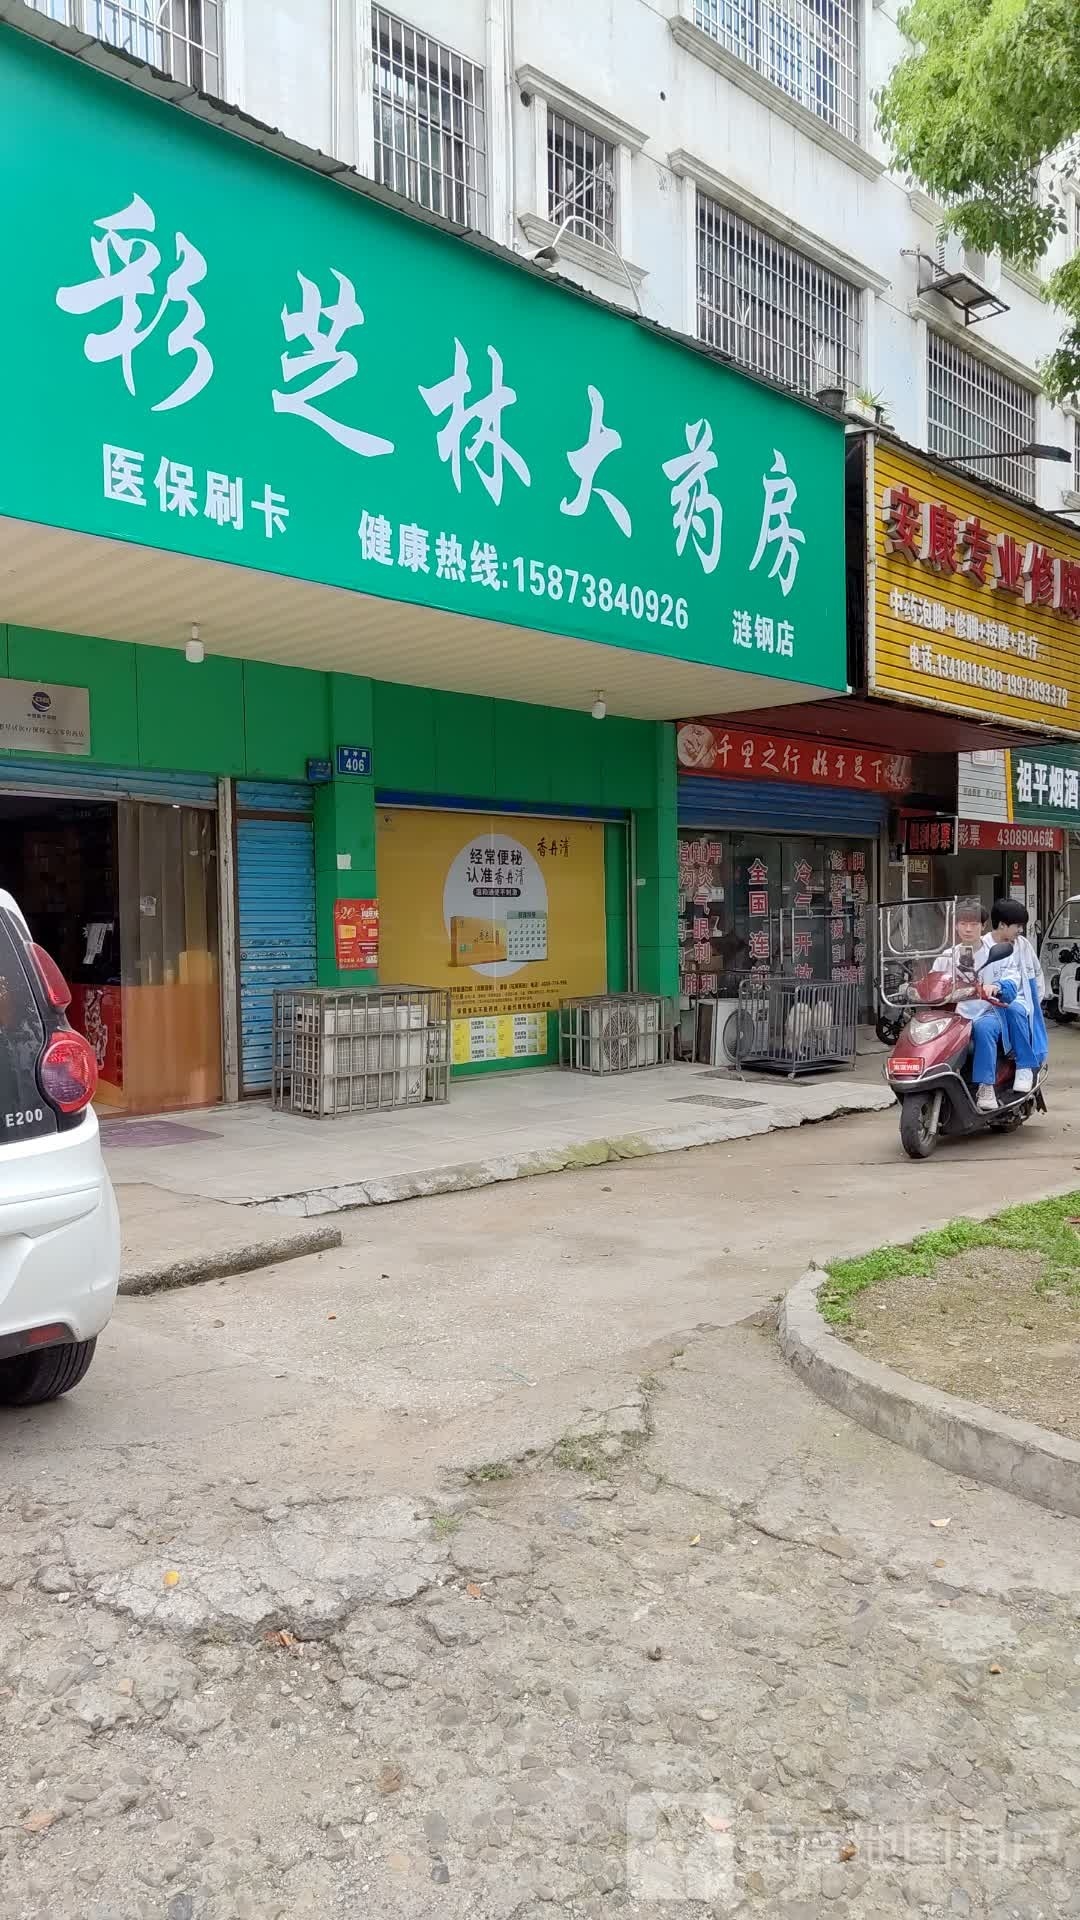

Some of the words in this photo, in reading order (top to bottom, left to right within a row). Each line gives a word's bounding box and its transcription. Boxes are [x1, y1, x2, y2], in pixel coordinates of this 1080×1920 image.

[56, 193, 806, 597] 彩芝林大药房
[103, 443, 290, 538] 医保刷卡
[358, 509, 689, 630] 健康热线:15873840926
[732, 610, 795, 657] 涟钢店
[346, 758, 365, 772] 406
[717, 734, 800, 775] 千里之行
[812, 749, 883, 784] 始于足下
[1016, 759, 1080, 810] 祖平烟酒
[470, 848, 523, 866] 经常便秘
[5, 1108, 43, 1127] E200
